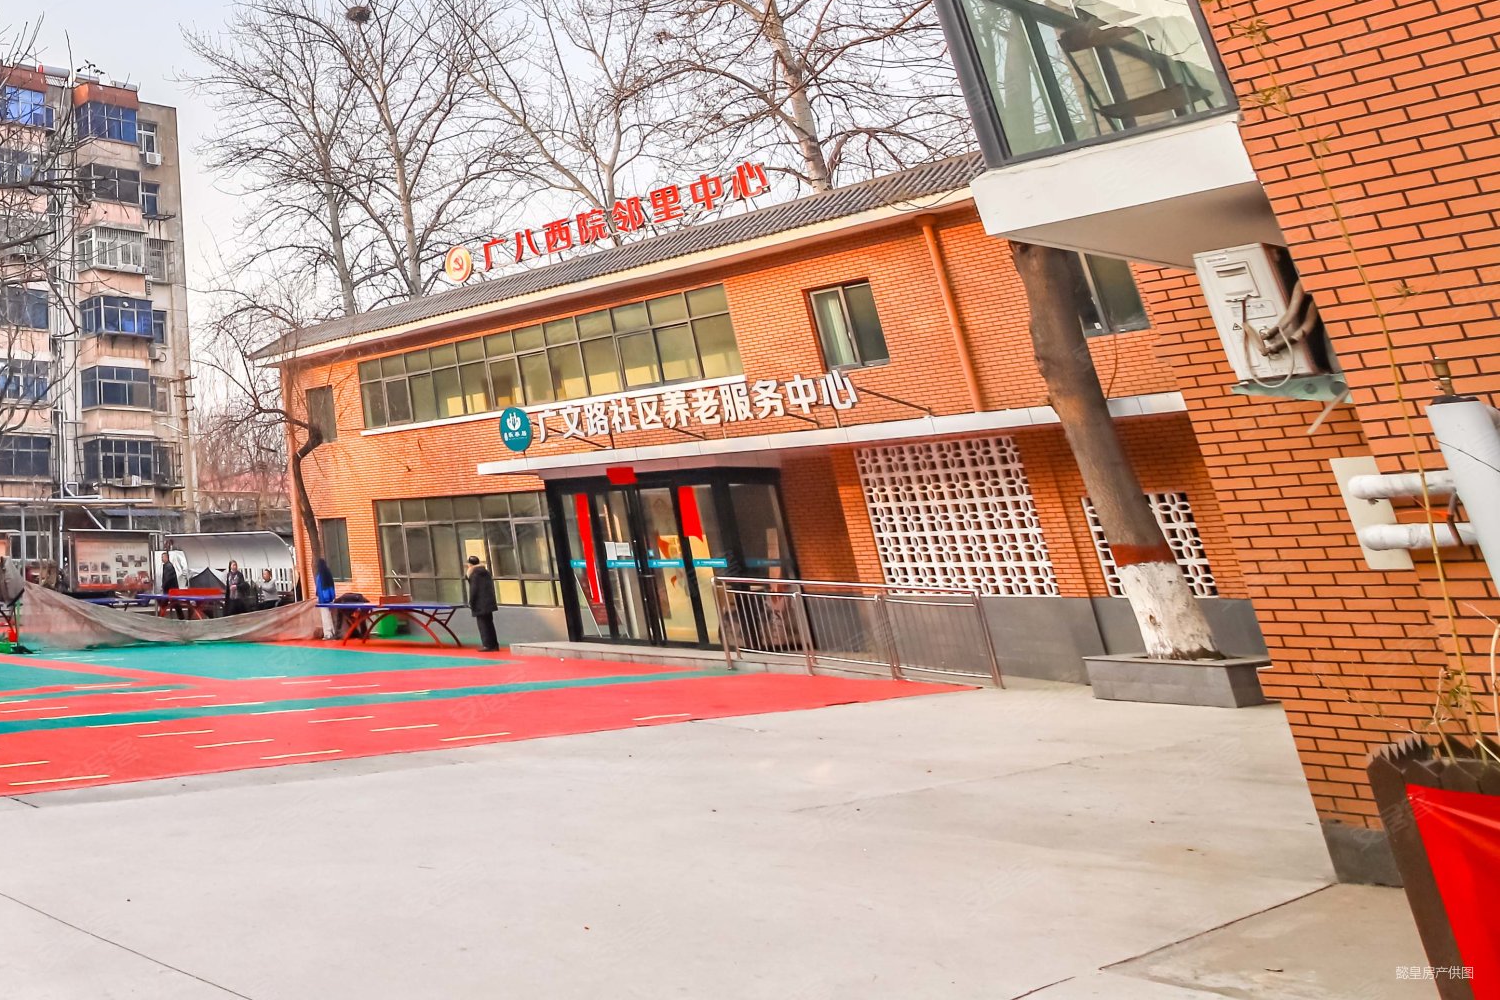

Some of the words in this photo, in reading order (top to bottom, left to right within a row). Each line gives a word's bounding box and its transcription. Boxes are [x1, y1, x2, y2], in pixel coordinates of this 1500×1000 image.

[482, 161, 770, 272] 广八西院邻里中心
[536, 369, 858, 442] 广文路社区养老服务中心
